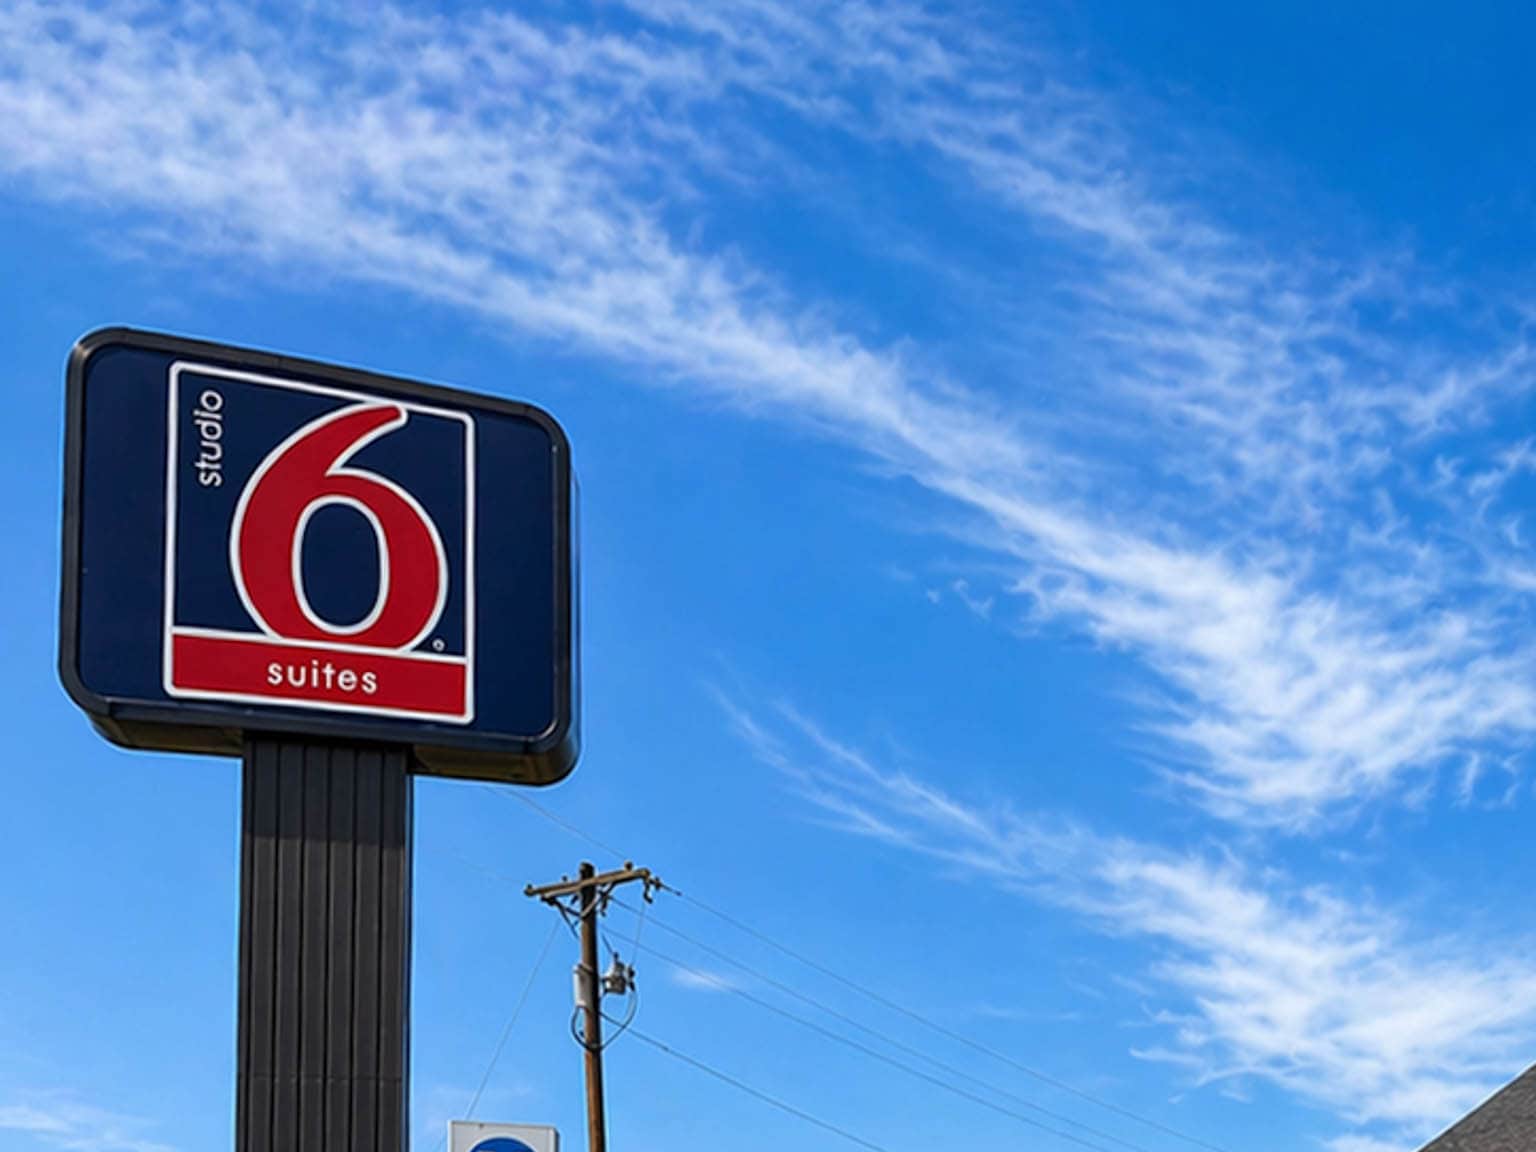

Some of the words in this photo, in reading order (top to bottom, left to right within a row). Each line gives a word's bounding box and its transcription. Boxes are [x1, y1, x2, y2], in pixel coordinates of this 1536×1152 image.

[194, 389, 223, 487] studio
[229, 401, 448, 655] 6
[266, 659, 378, 694] suites
